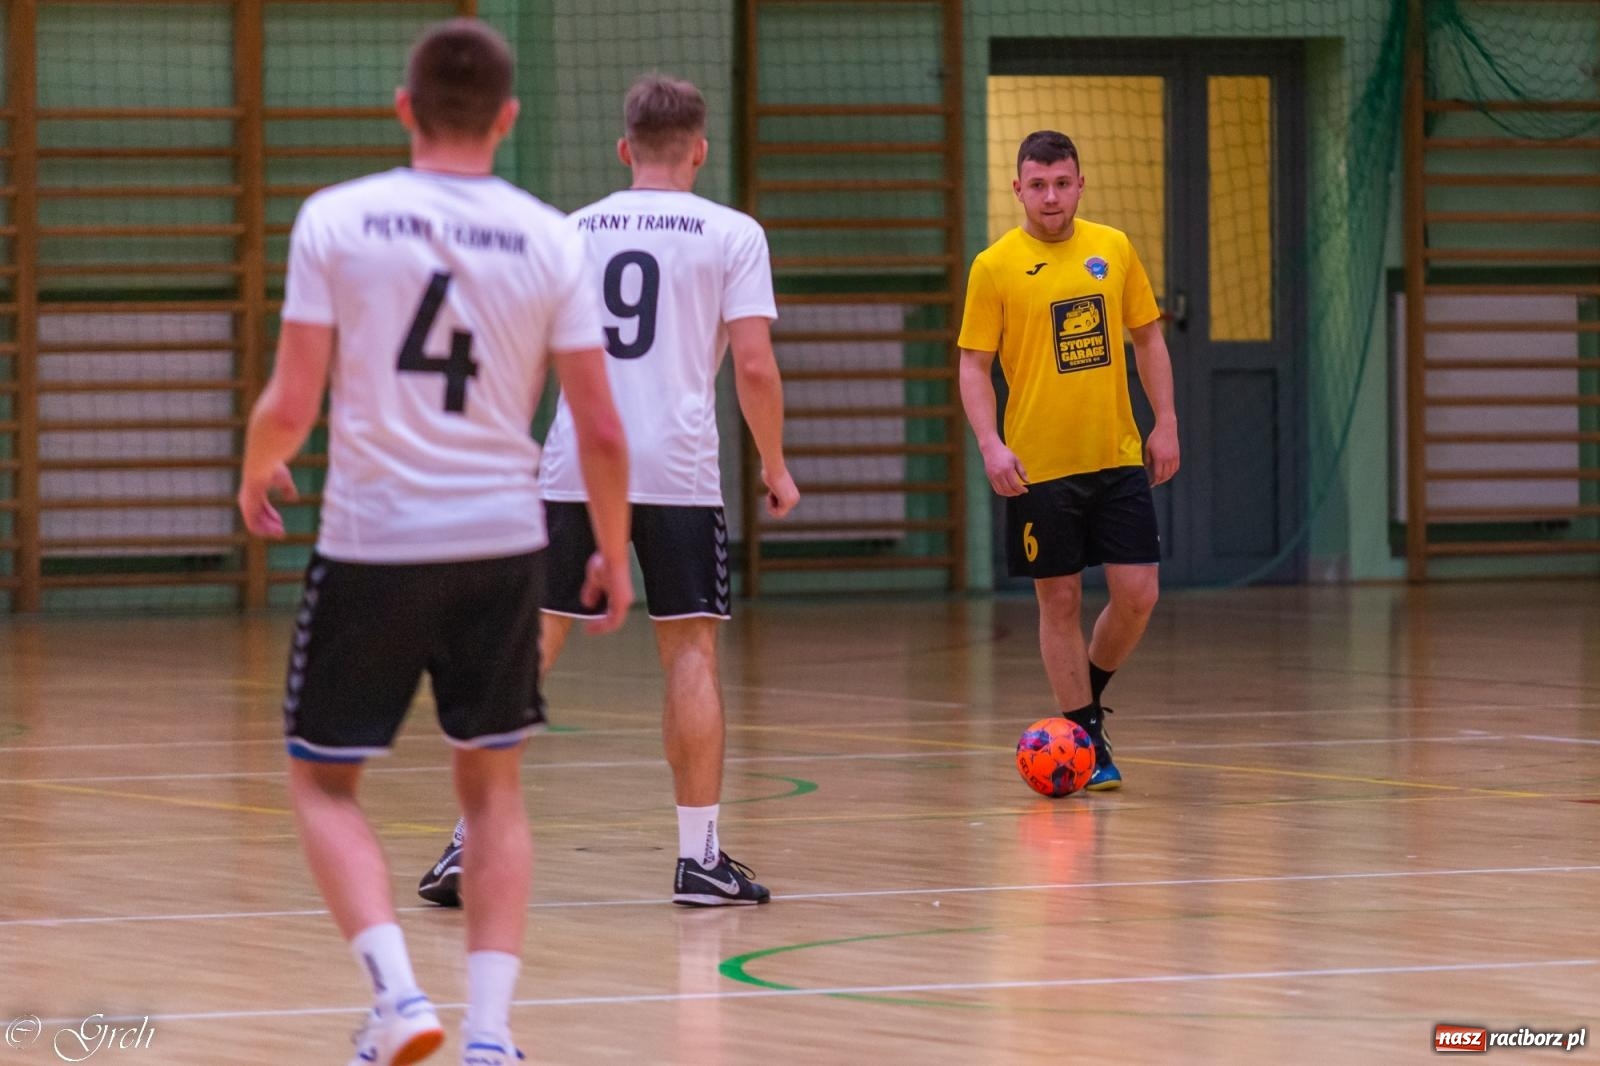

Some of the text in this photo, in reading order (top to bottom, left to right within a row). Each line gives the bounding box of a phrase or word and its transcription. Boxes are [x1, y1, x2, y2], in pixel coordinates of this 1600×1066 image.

[577, 214, 706, 236] PIĘKNY TRAWNIK
[604, 250, 661, 360] 9
[396, 271, 477, 413] 4
[1059, 335, 1104, 352] STOPIW
[1061, 346, 1105, 362] GARAGE
[1023, 522, 1039, 563] 6
[1019, 757, 1047, 792] SELECT
